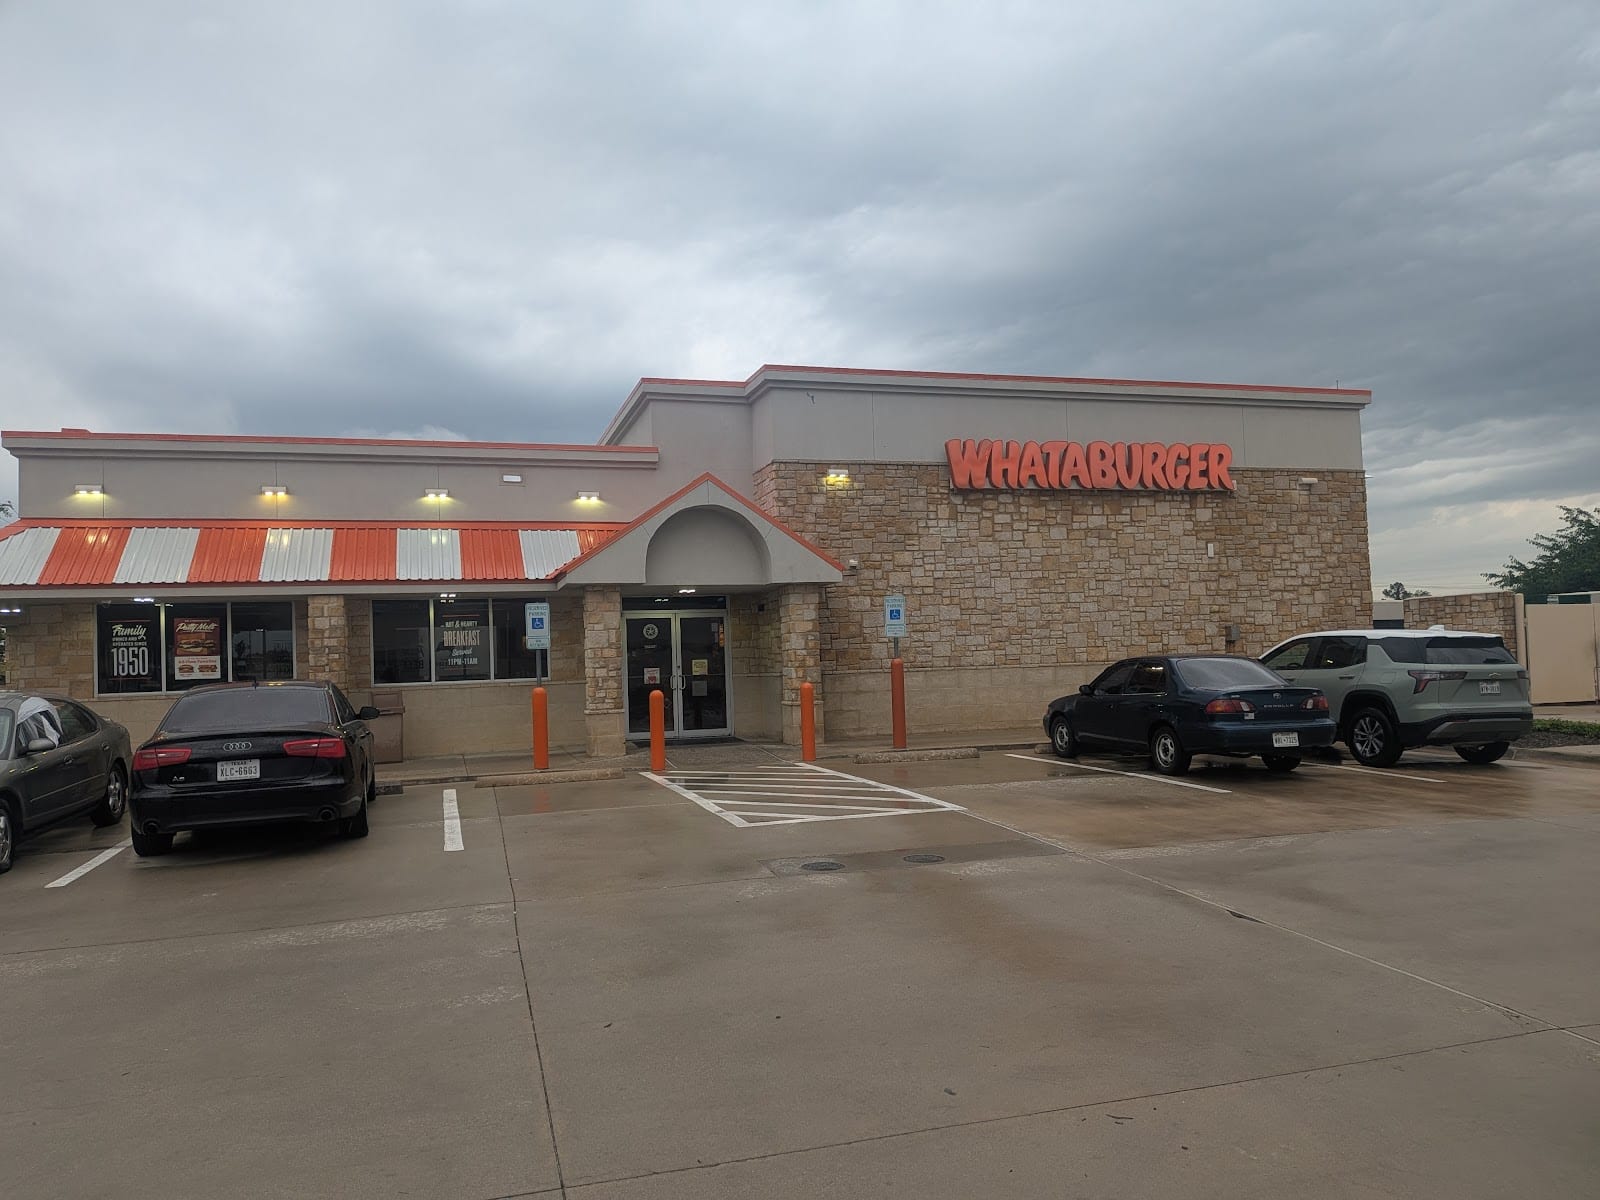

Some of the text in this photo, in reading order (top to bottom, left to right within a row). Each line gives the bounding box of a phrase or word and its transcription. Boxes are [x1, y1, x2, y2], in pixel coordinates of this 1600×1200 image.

[945, 438, 1234, 490] WHATABURGER
[112, 624, 147, 640] Family
[443, 630, 480, 647] BREAKFAST
[111, 646, 149, 676] 1950
